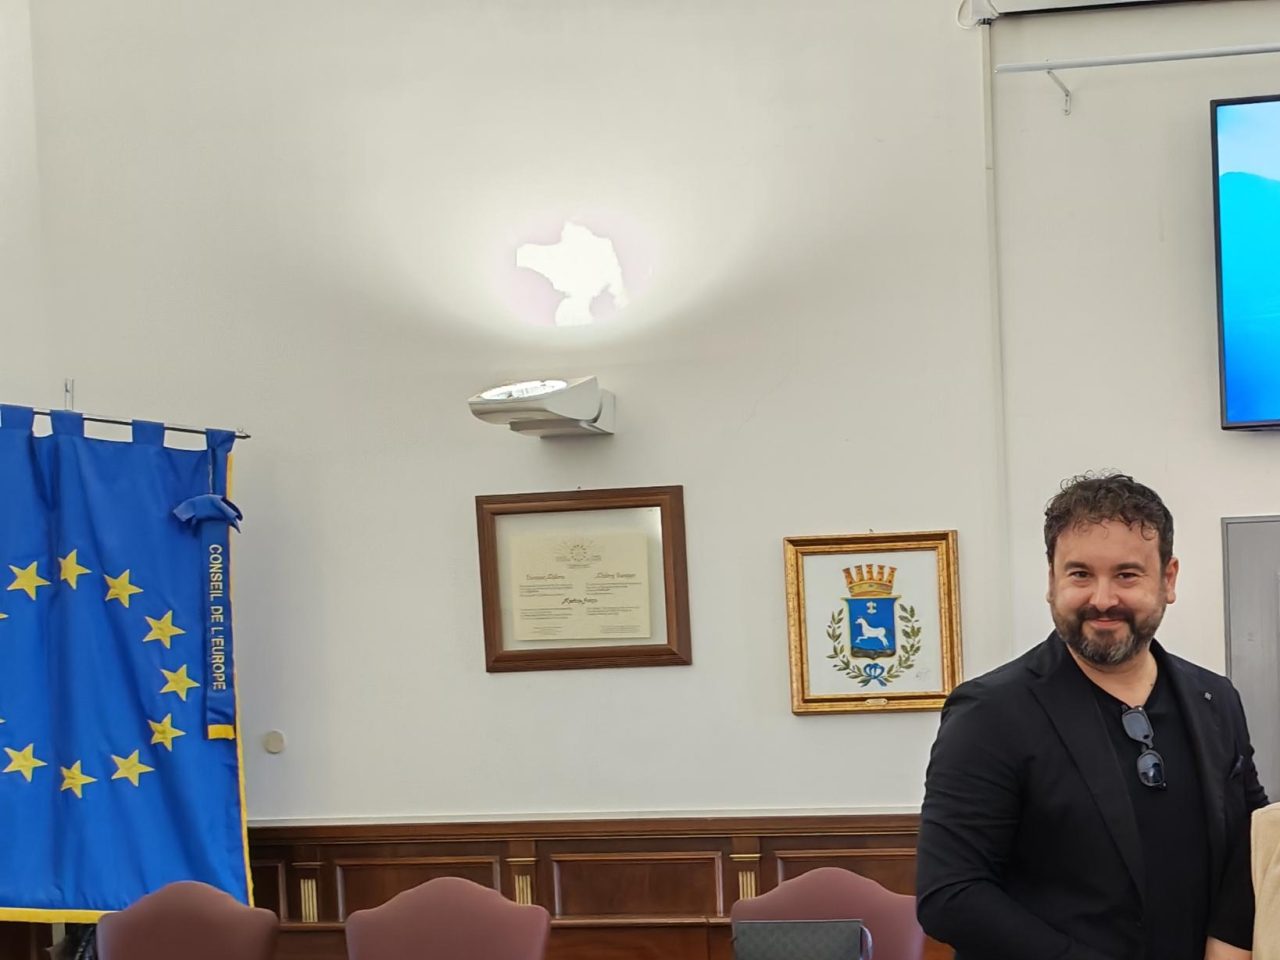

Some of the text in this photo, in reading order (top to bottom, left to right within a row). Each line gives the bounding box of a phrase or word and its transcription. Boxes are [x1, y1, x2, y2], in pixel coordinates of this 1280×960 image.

[209, 544, 227, 691] CONSEIL DE L'EUROPE
